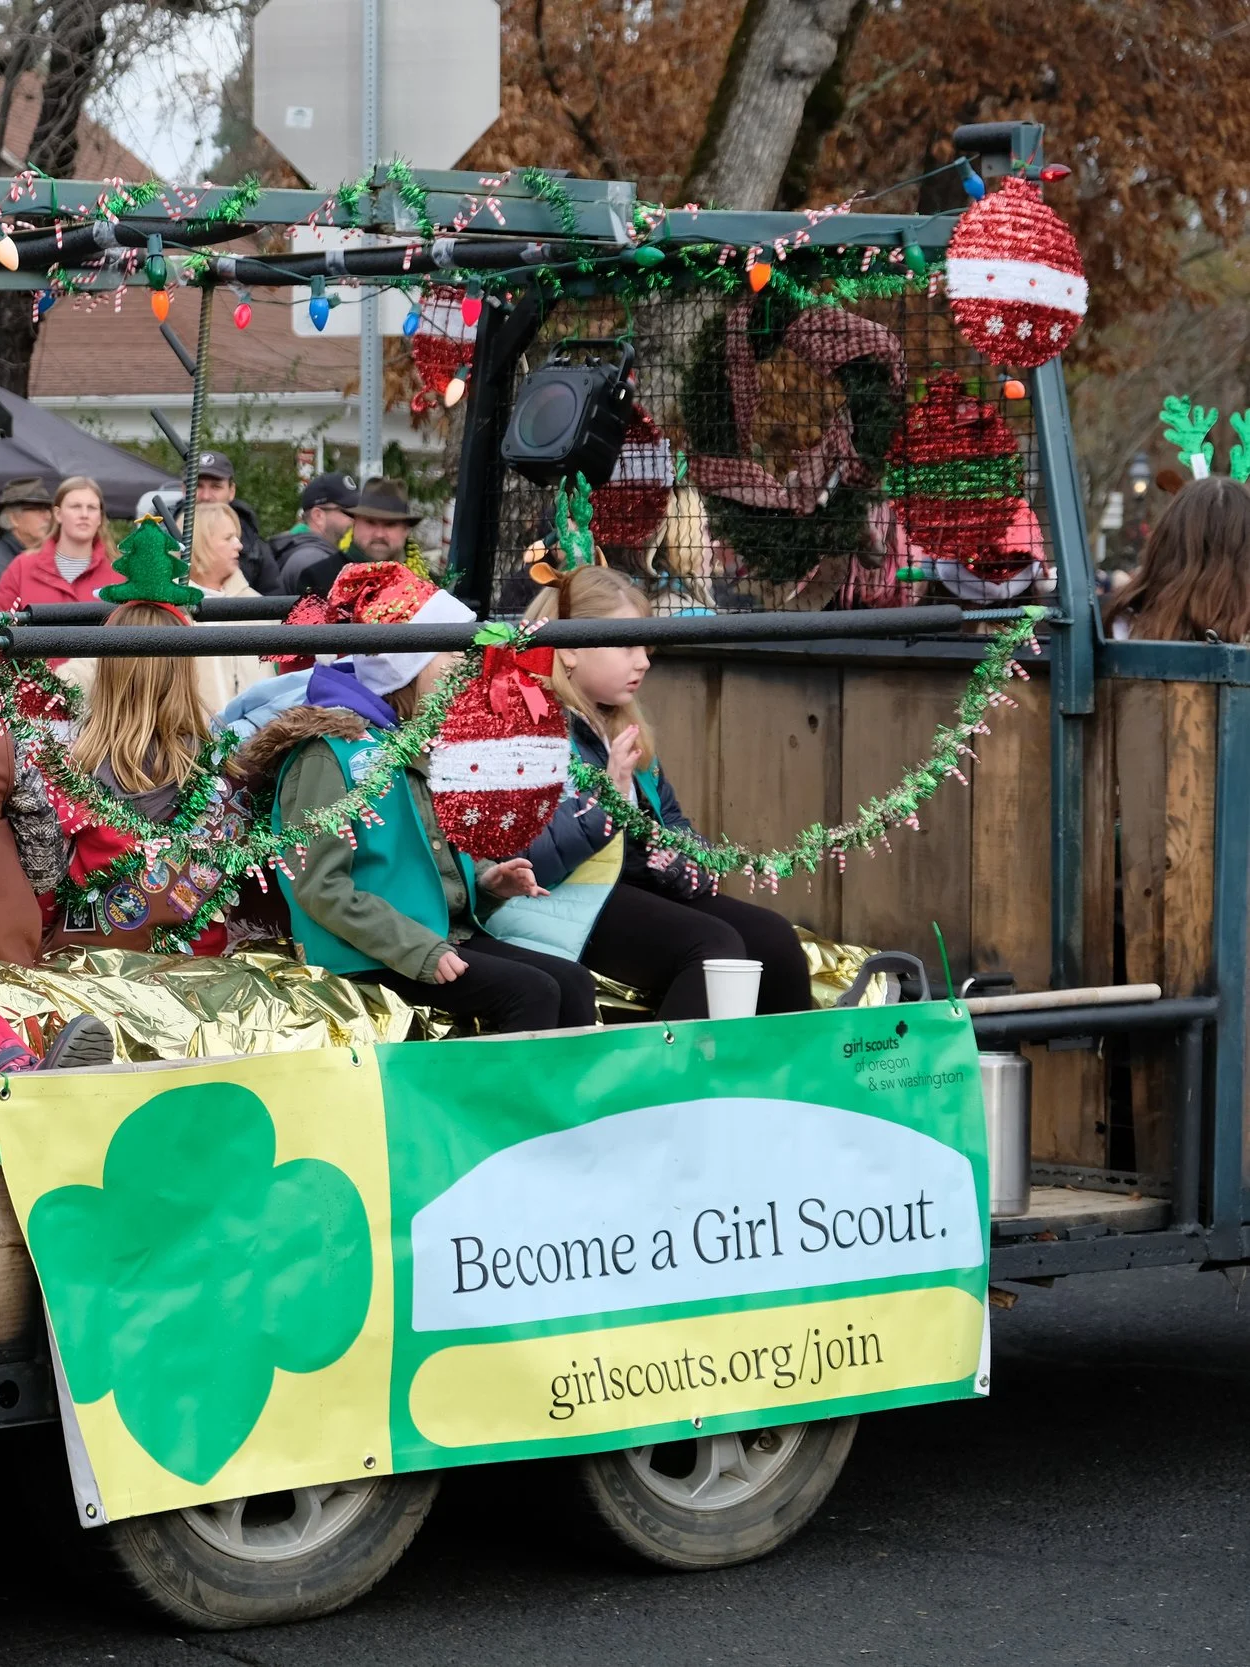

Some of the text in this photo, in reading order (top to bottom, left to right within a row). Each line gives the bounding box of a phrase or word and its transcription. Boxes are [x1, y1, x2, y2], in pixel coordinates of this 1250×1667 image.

[843, 1037, 900, 1058] girl scouts
[855, 1056, 910, 1073] of oregon
[868, 1071, 964, 1091] & sw washington
[450, 1189, 948, 1294] Become a Girl Scout.
[548, 1323, 884, 1420] girlscouts.org/join
